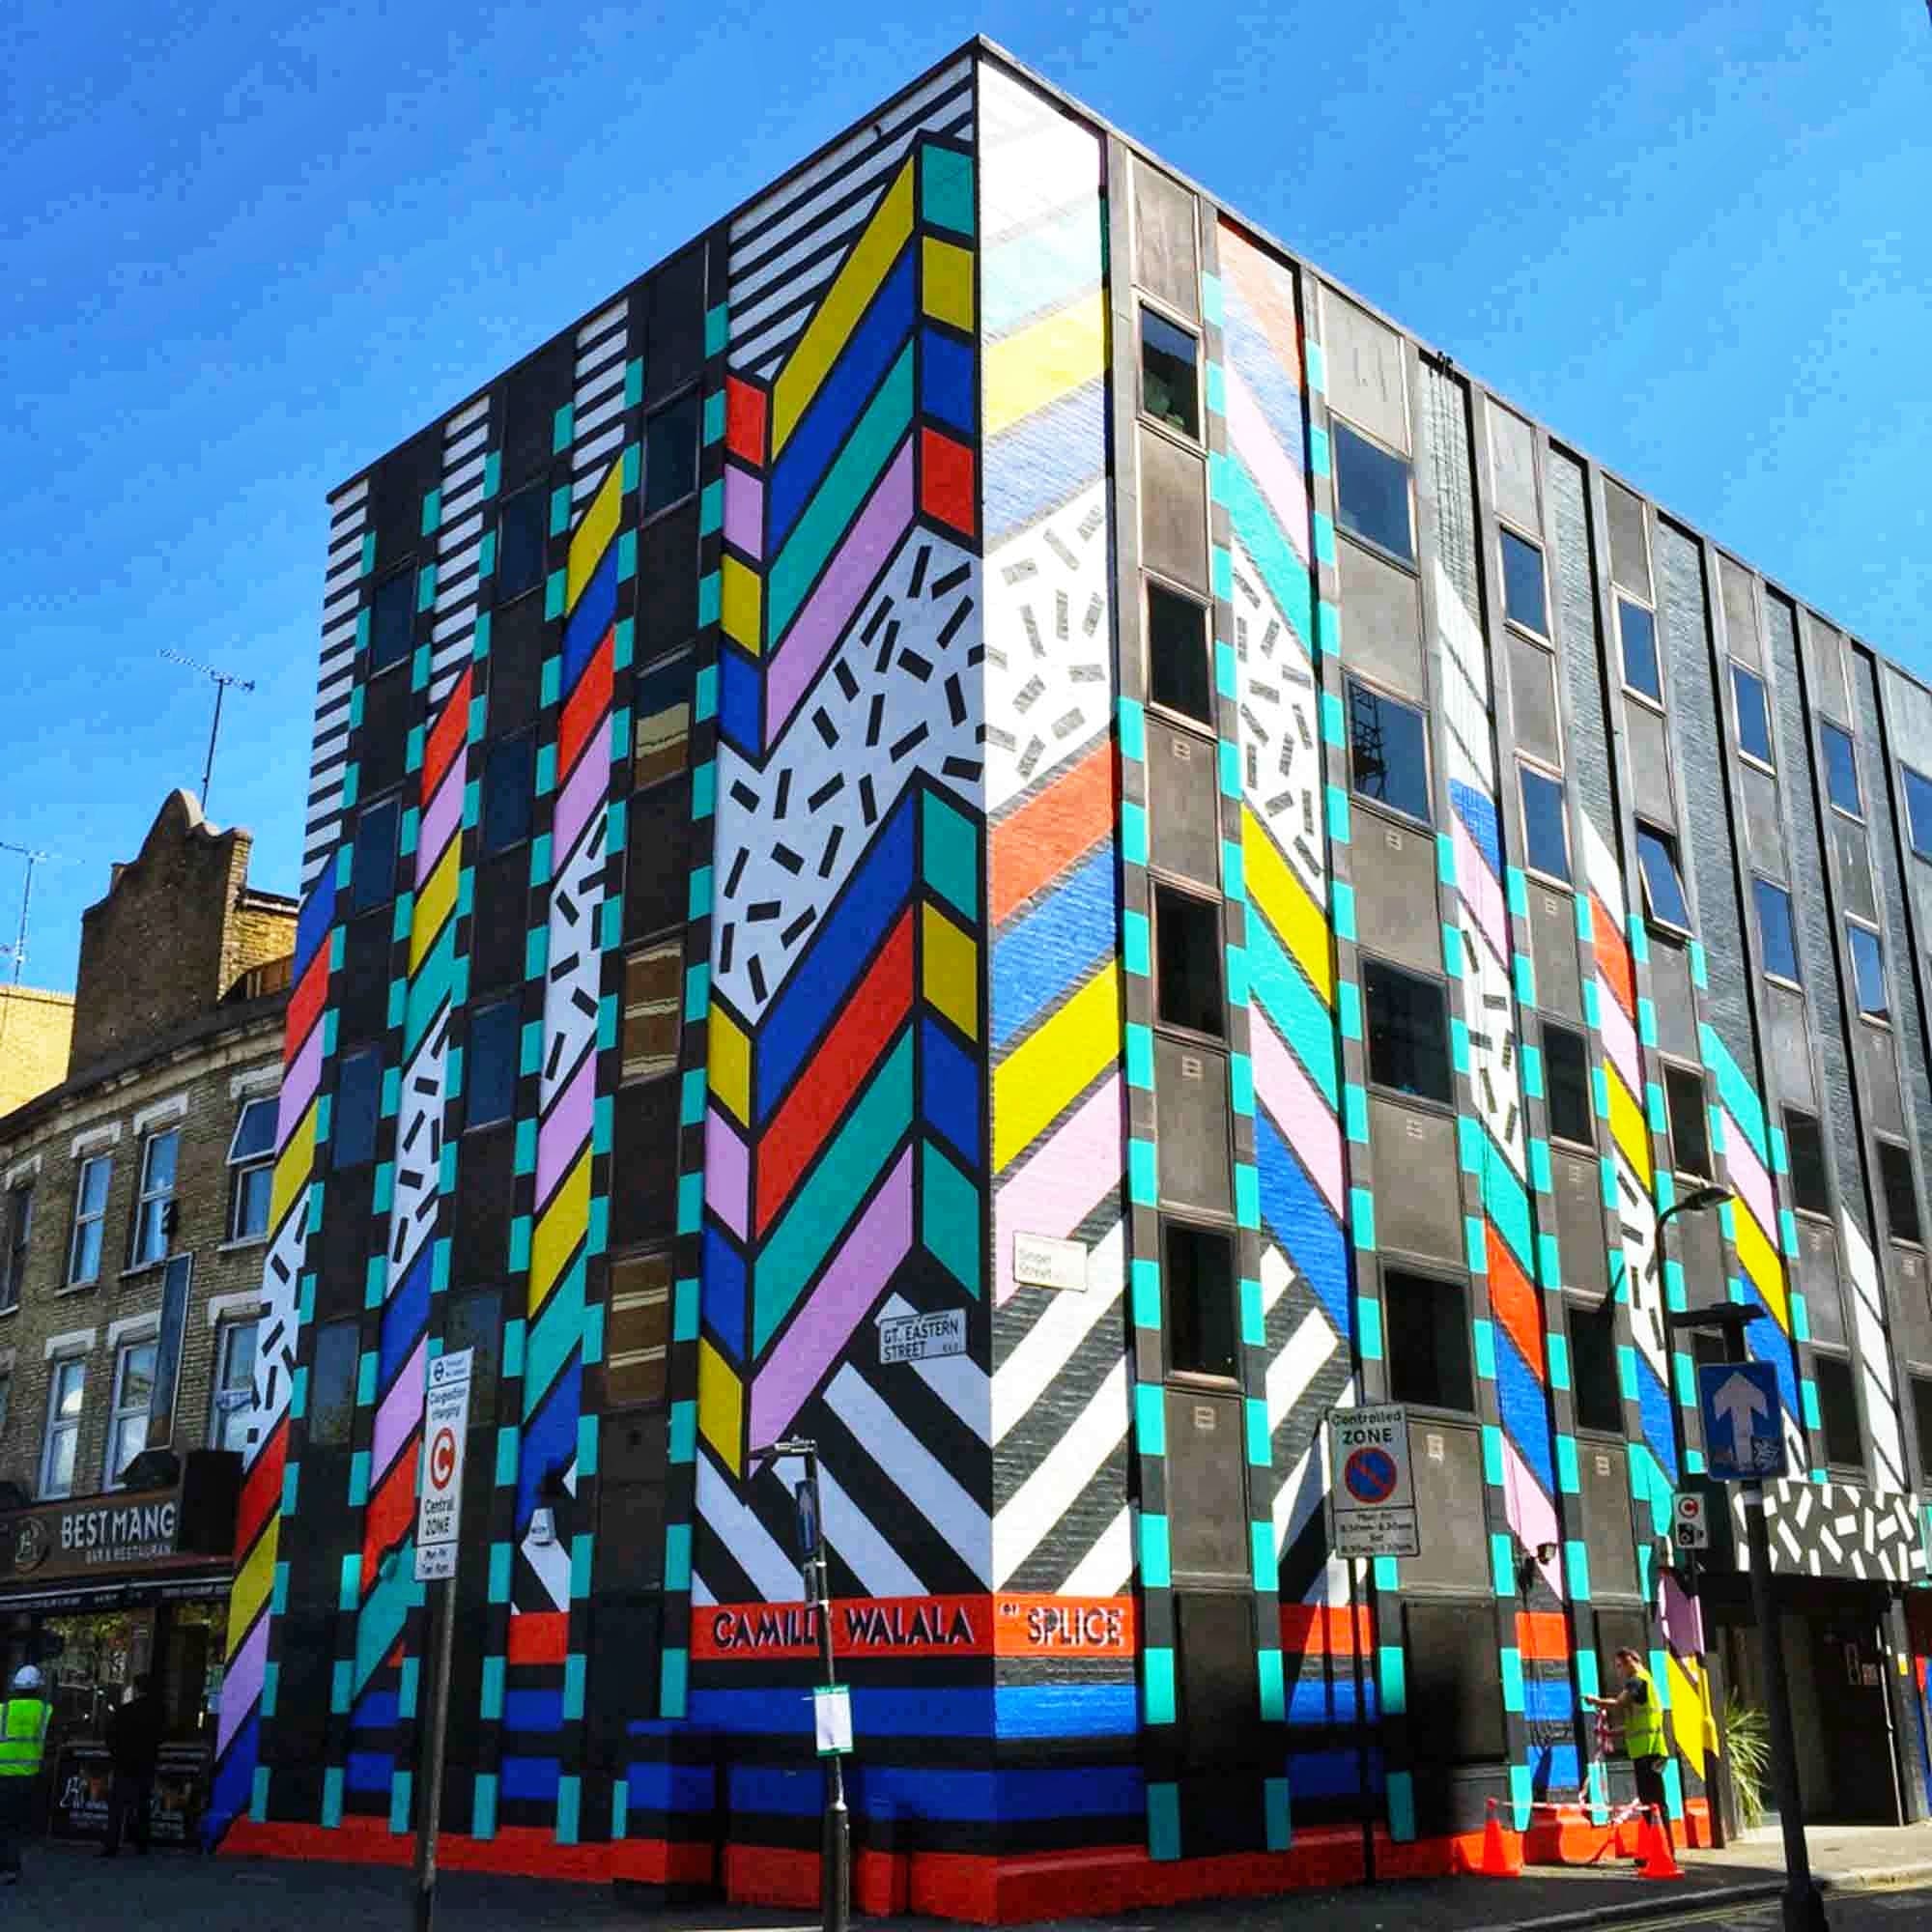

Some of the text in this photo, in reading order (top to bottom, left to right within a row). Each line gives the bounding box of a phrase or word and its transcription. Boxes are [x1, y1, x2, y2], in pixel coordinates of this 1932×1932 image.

[905, 1318, 959, 1341] EASTERN
[884, 1341, 926, 1361] STREET
[1332, 1411, 1402, 1425] Controlled
[1343, 1429, 1393, 1445] ZONE
[424, 1496, 454, 1514] Central
[61, 1501, 178, 1549] BEST MANG
[425, 1516, 451, 1536] ZONE
[713, 1602, 975, 1649] CAMILL WALALA
[1027, 1606, 1124, 1647] SPLICE
